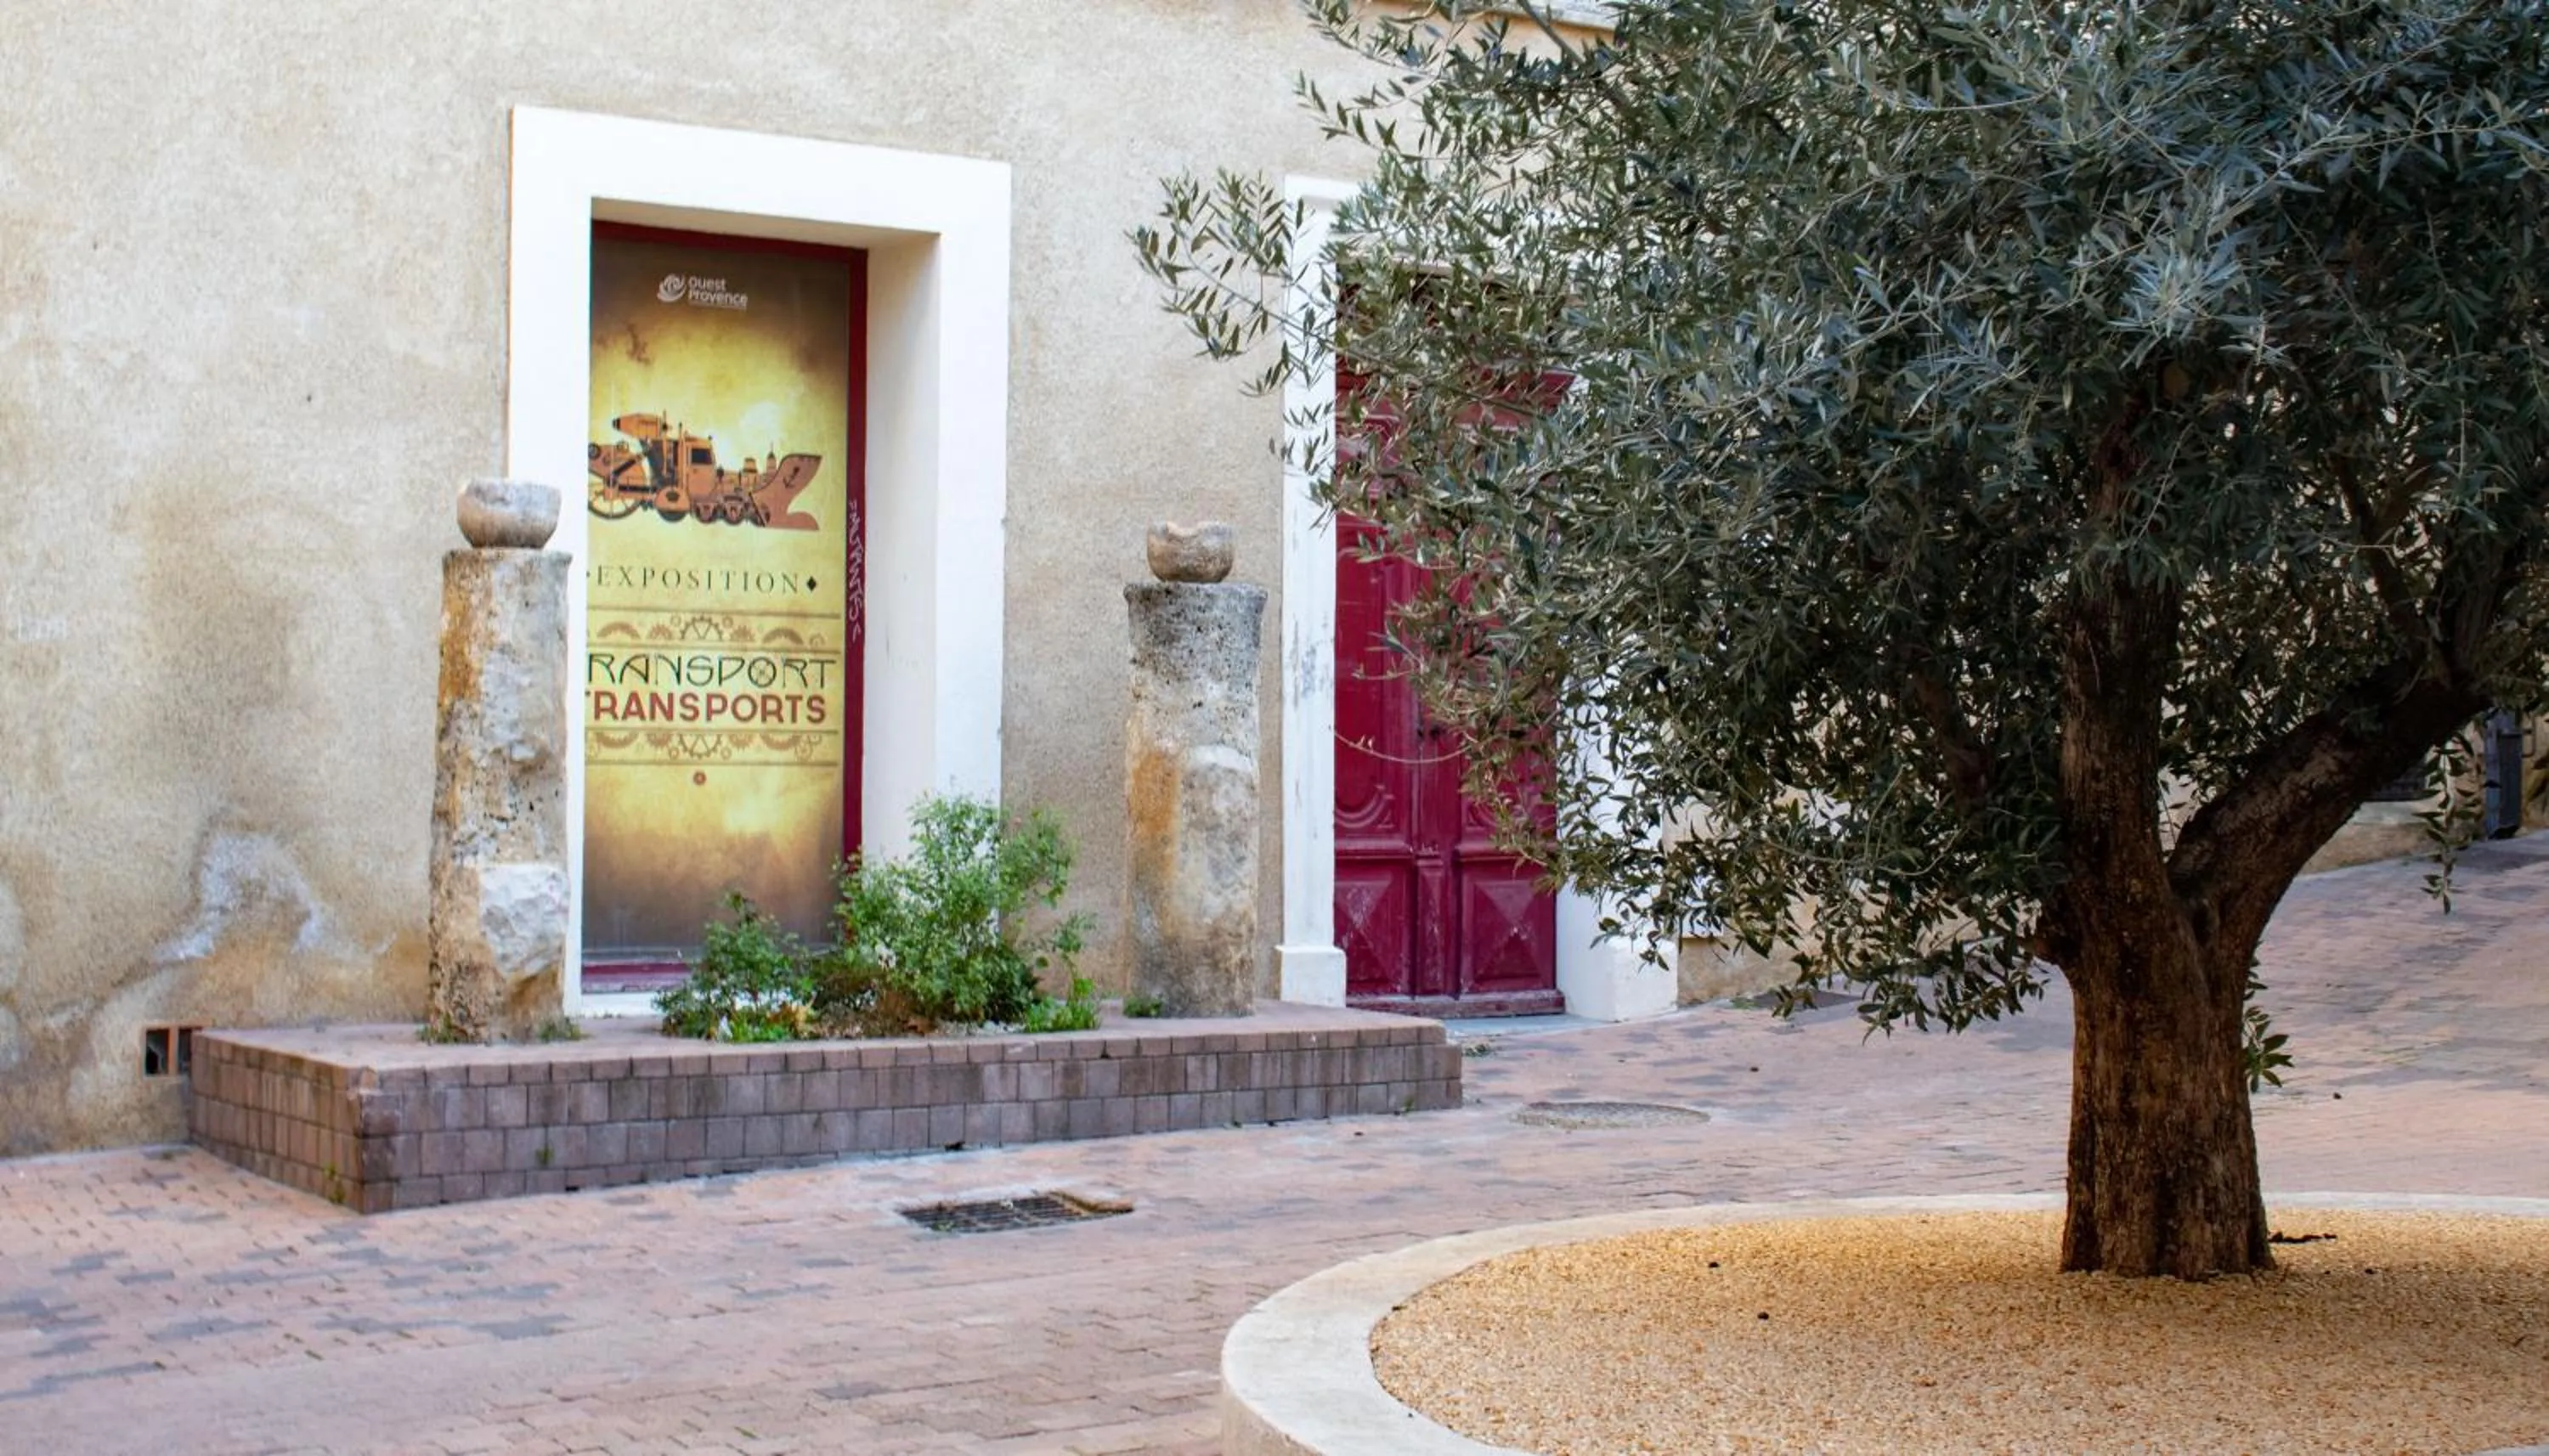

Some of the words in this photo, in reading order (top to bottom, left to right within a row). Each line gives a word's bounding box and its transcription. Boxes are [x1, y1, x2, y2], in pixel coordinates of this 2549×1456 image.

[689, 290, 748, 306] Provence
[597, 565, 799, 594] EXPOSITION
[588, 653, 837, 689] RANSPORT
[586, 691, 826, 724] RANSPORTS
